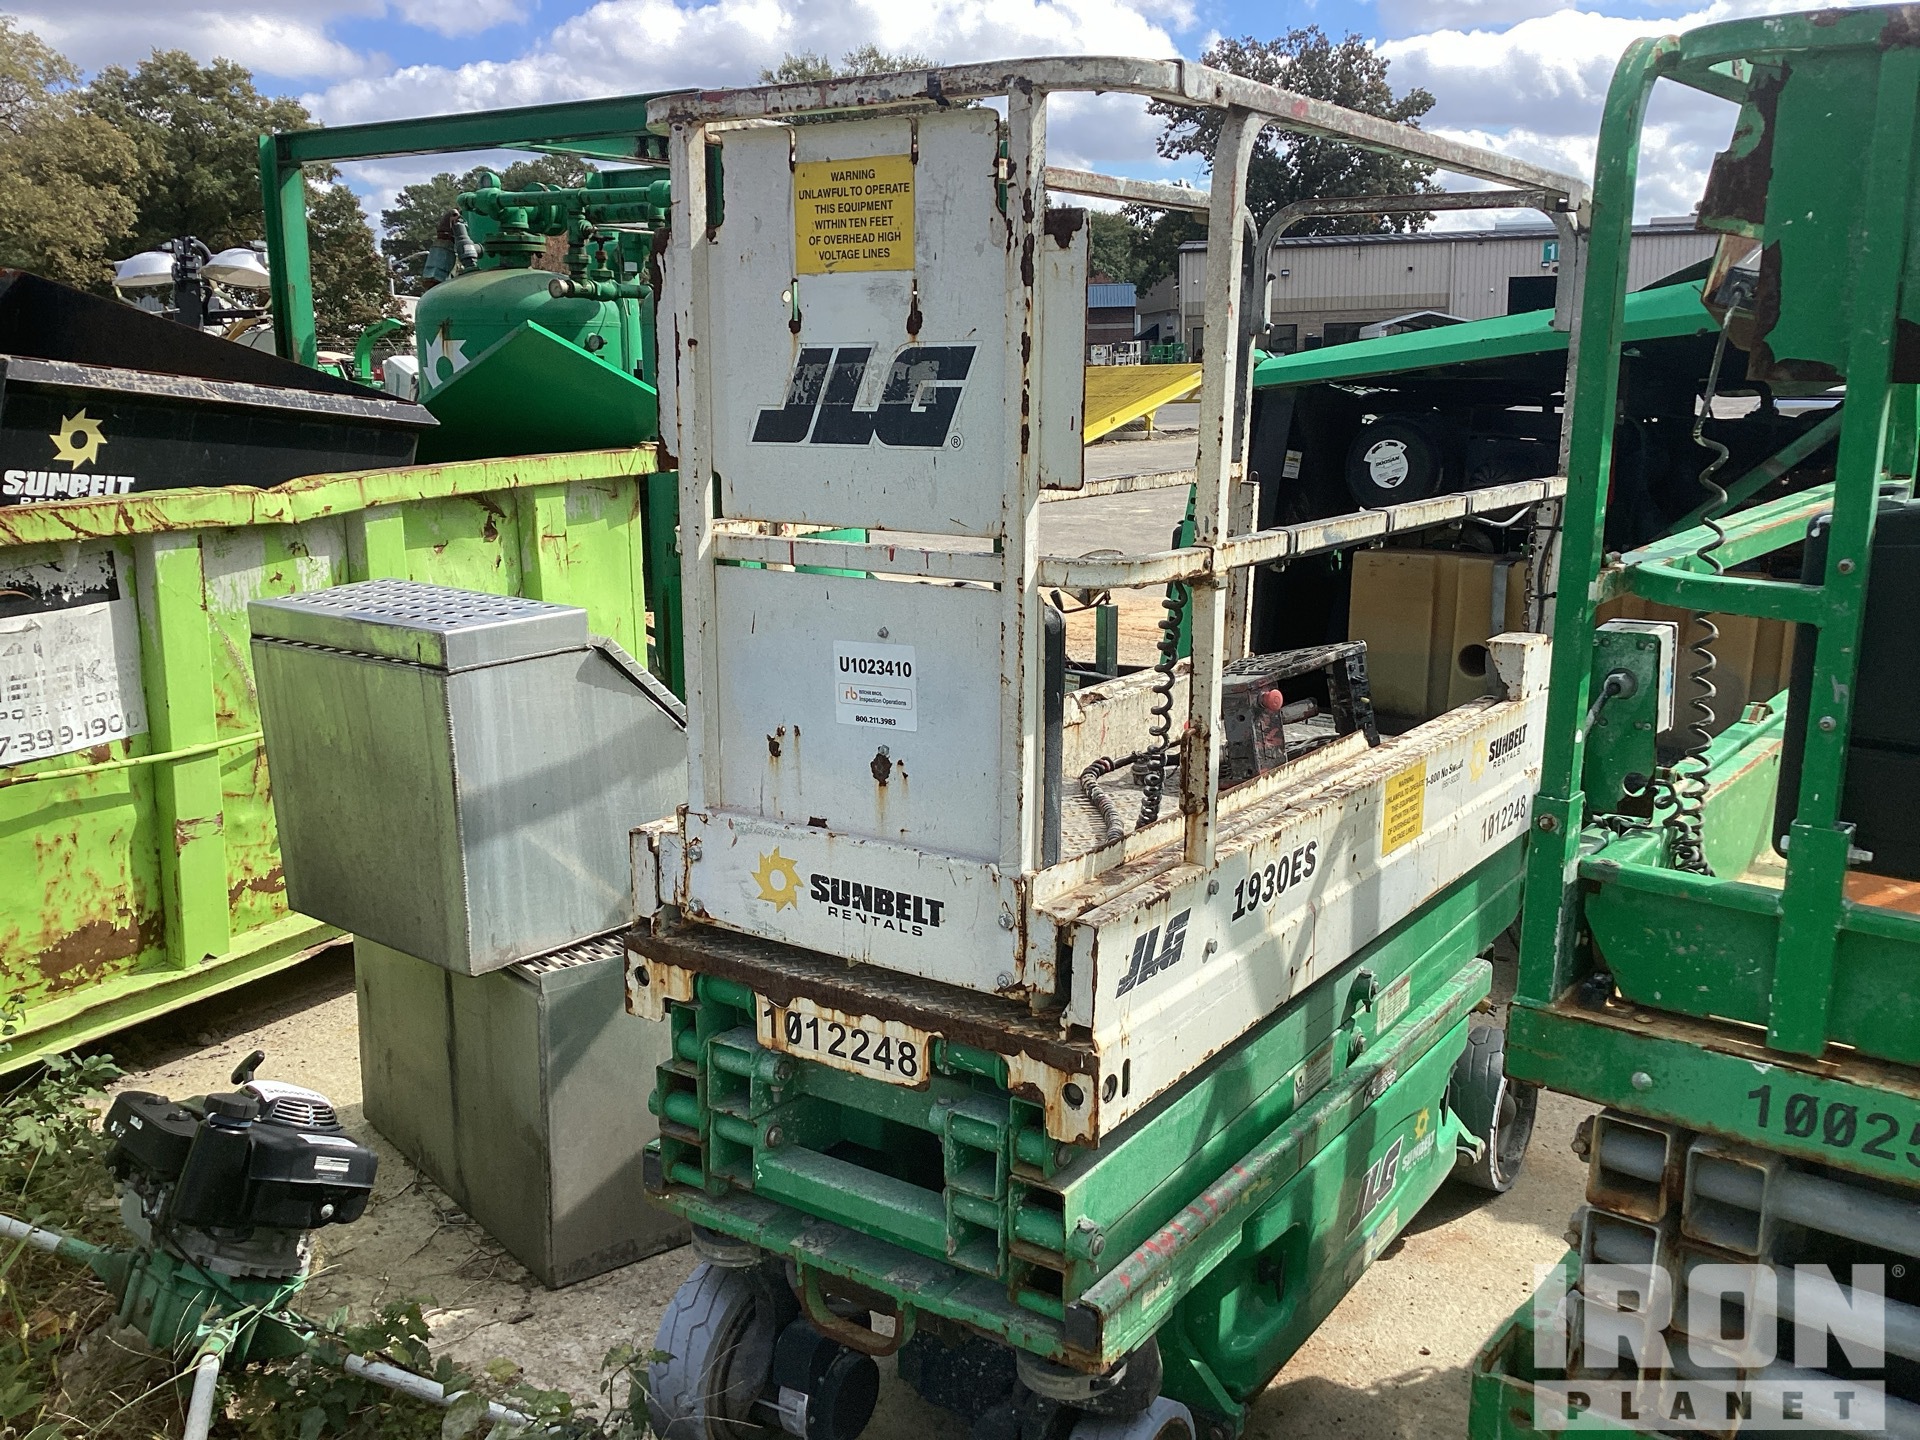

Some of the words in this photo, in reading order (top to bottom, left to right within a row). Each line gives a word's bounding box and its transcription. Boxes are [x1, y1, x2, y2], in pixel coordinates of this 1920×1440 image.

[831, 169, 875, 181] WARNING
[799, 187, 849, 200] UNLAWFUL
[850, 186, 862, 196] TO
[865, 183, 910, 195] OPERATE
[815, 204, 835, 214] THIS
[838, 200, 893, 213] EQUIPMENT
[815, 219, 847, 230] WITHIN
[848, 217, 867, 228] TEN
[869, 216, 894, 226] FEET
[808, 236, 821, 246] OF
[823, 233, 875, 245] OVERHEAD
[877, 231, 901, 242] HIGH
[819, 249, 860, 260] VOLTAGE
[863, 248, 890, 258] LINES
[751, 345, 977, 447] JLG
[2, 469, 135, 498] SUNBELT
[839, 656, 912, 678] U1023410
[855, 715, 897, 726] 800.211.3983
[1489, 723, 1528, 762] SUNBELT
[1493, 748, 1521, 769] RENTALS
[1481, 794, 1526, 843] 1012248
[1231, 840, 1318, 922] 1930ES
[810, 873, 944, 928] SUNBELT
[828, 906, 923, 937] RENTALS
[1115, 907, 1191, 999] JLG
[763, 1006, 918, 1077] 1012248
